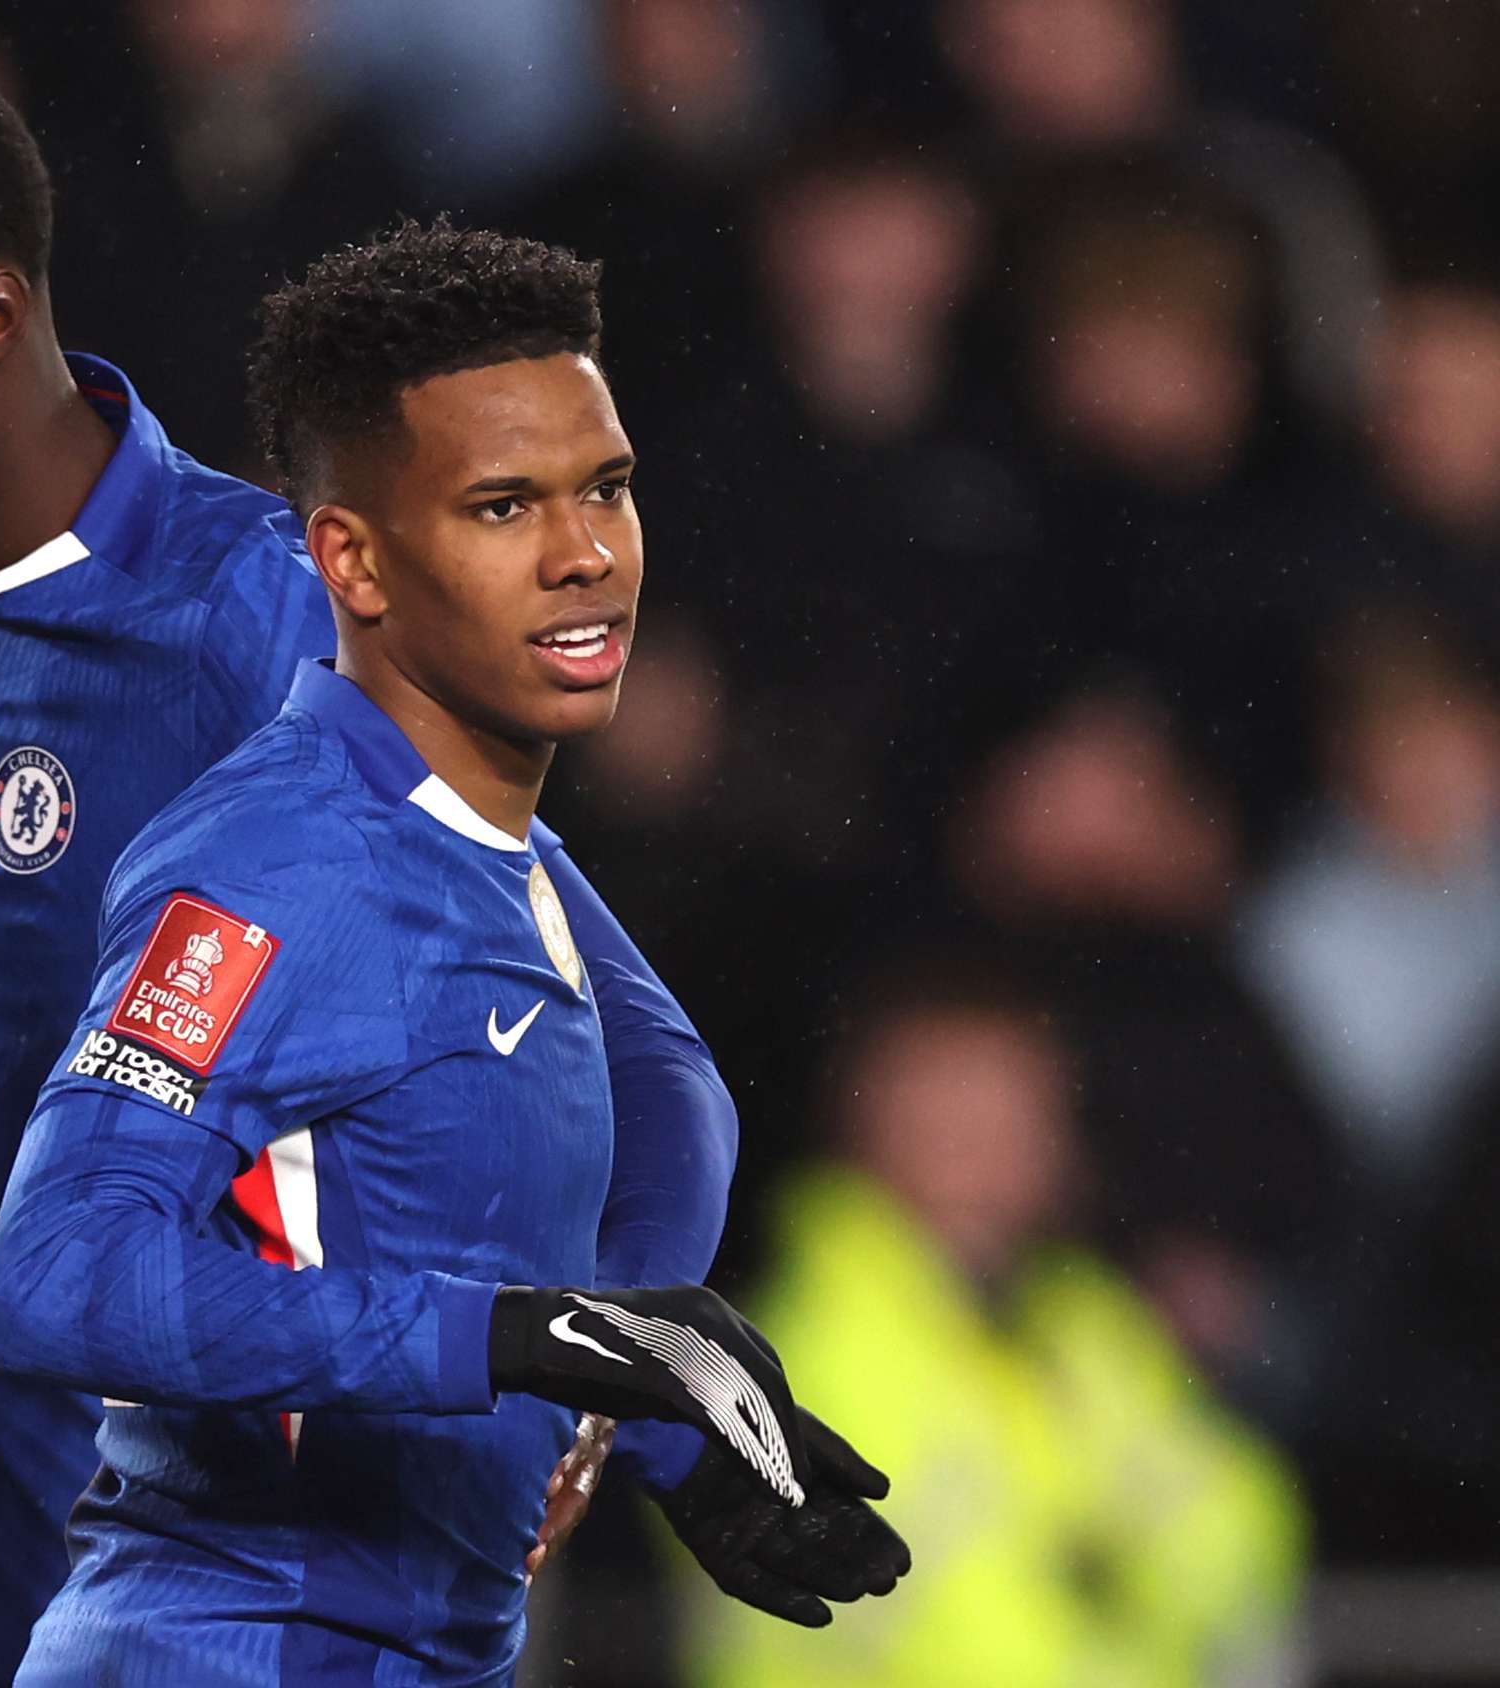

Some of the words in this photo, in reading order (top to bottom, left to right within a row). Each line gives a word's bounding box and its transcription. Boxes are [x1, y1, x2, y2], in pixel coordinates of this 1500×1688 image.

[8, 751, 65, 787] CHELSEA
[126, 999, 152, 1024] FA
[156, 1012, 208, 1046] CUP
[136, 980, 216, 1030] Emirates
[66, 1050, 106, 1078] for
[103, 1060, 197, 1117] racism
[83, 1029, 117, 1057] No
[117, 1044, 193, 1088] room
